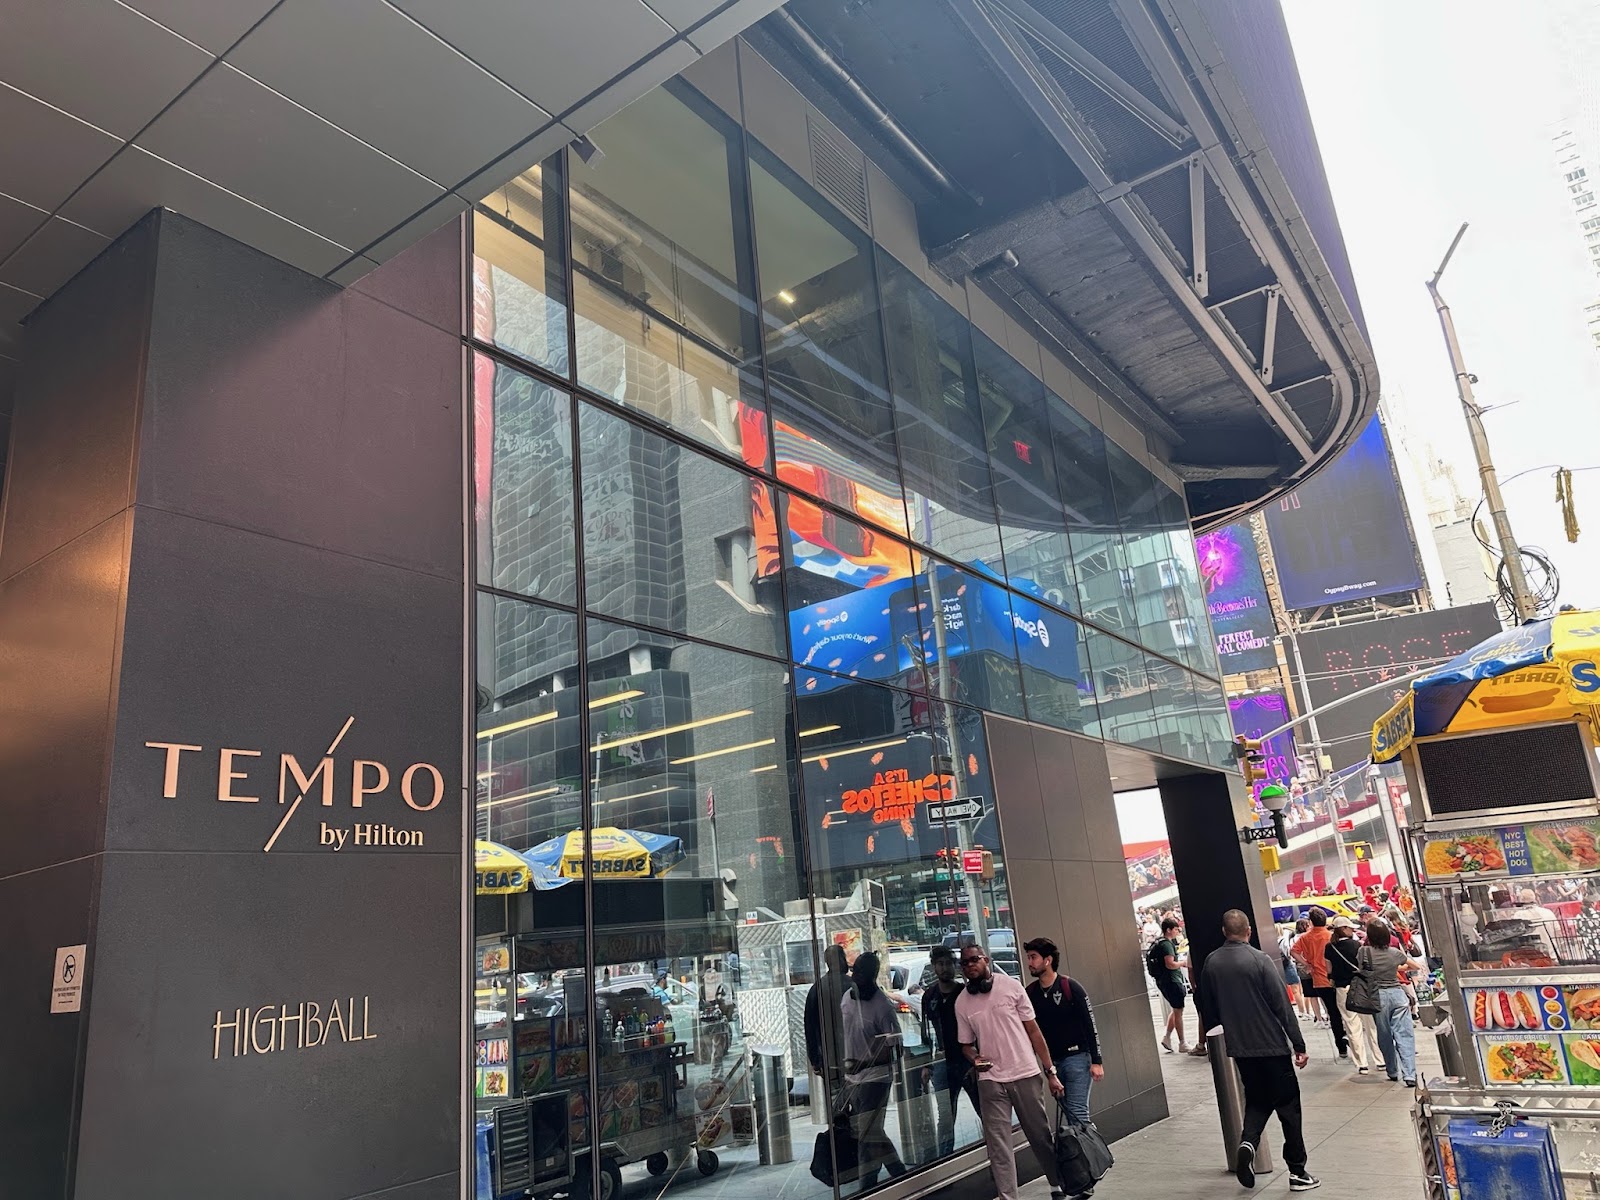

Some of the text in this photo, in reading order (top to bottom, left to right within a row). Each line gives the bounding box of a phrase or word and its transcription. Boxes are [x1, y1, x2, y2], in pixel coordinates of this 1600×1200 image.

[1218, 629, 1254, 645] PERFECT
[144, 716, 446, 853] TEMPO
[1572, 819, 1597, 828] GYRO
[319, 822, 424, 851] by Hilton
[1504, 831, 1521, 840] NYC
[1504, 840, 1525, 849] BEST
[1508, 849, 1525, 858] HOT
[1510, 858, 1528, 867] DOG
[212, 996, 378, 1060] HIGHBALL
